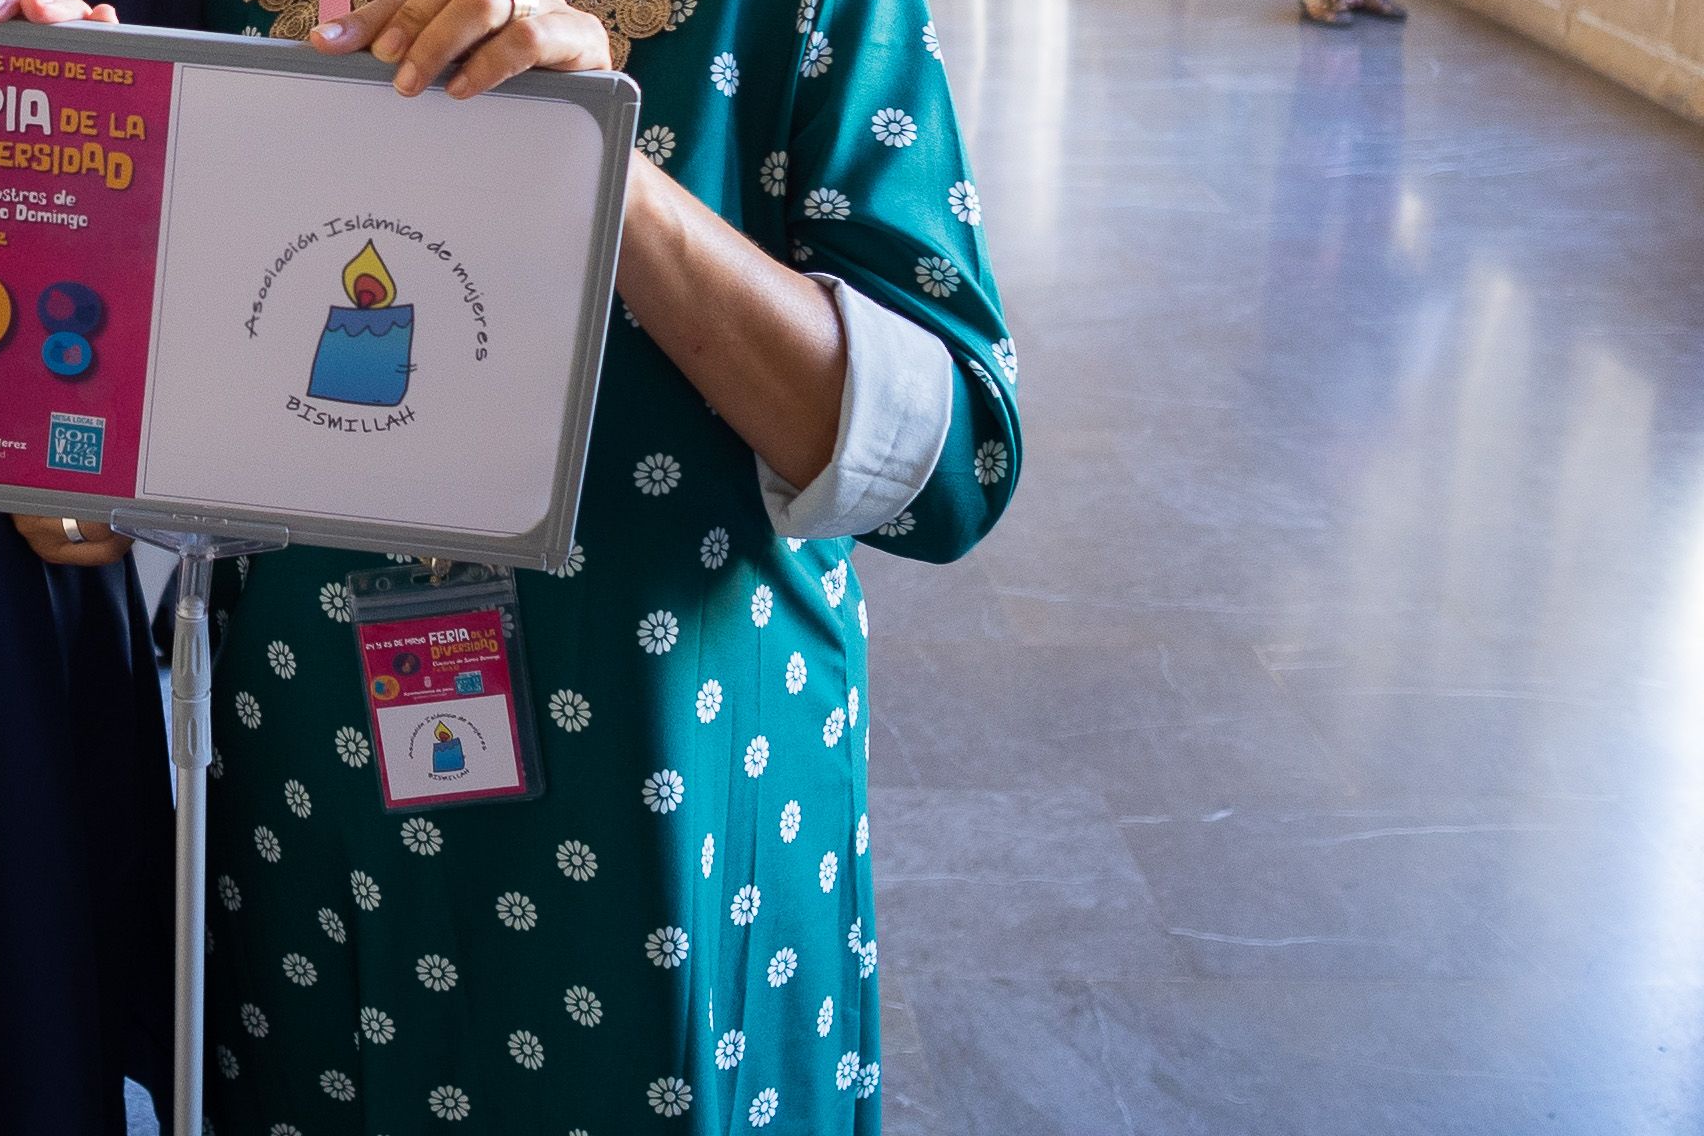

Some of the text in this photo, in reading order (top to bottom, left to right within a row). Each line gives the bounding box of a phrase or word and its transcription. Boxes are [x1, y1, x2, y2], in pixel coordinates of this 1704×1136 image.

[10, 56, 59, 76] MAYO
[64, 61, 86, 80] DE
[92, 67, 134, 85] 2023
[59, 108, 97, 135] DE
[109, 113, 145, 141] LA
[54, 190, 76, 207] de
[15, 205, 88, 229] Domingo
[245, 214, 488, 361] Asociación Islámica de mujeres
[286, 395, 415, 433] BISMILLAH
[428, 628, 470, 645] FERIA
